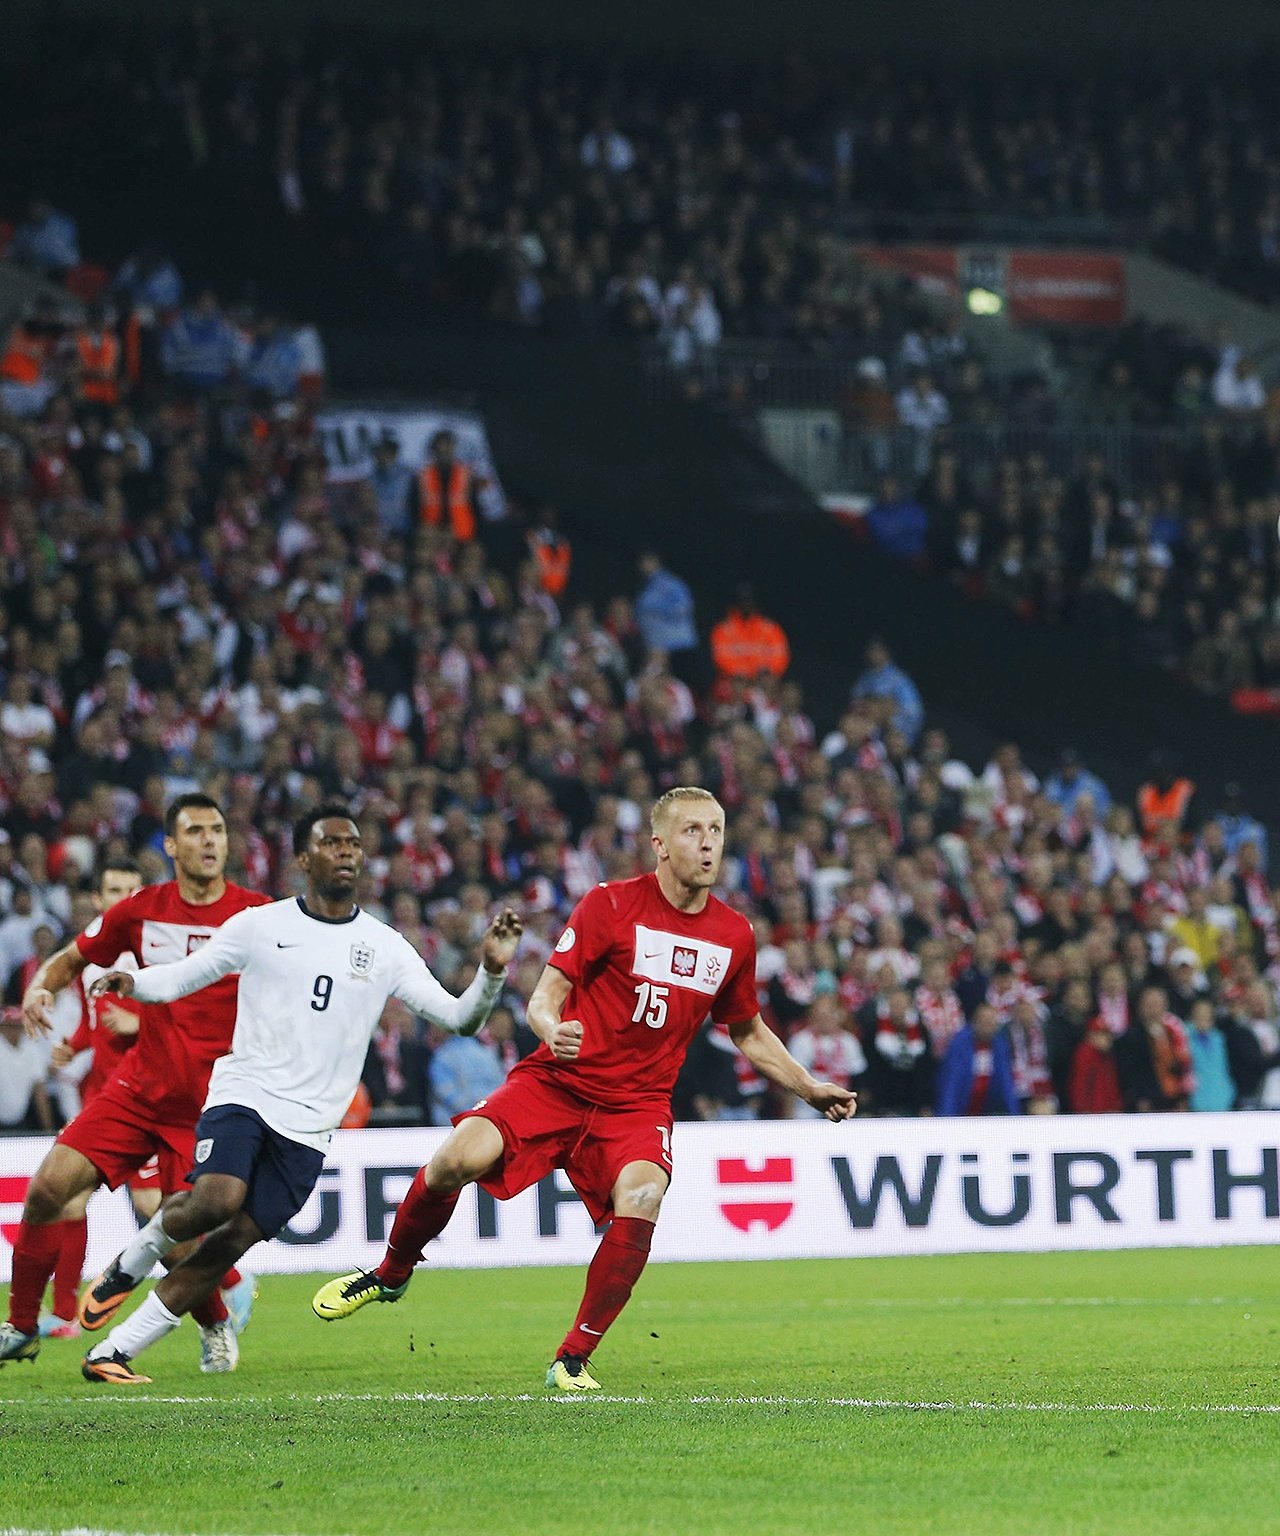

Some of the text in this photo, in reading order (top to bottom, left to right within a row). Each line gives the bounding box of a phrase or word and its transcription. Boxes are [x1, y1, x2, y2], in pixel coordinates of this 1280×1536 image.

[311, 974, 334, 1012] 9
[631, 982, 670, 1029] 15
[831, 1147, 1280, 1230] WÜRTH
